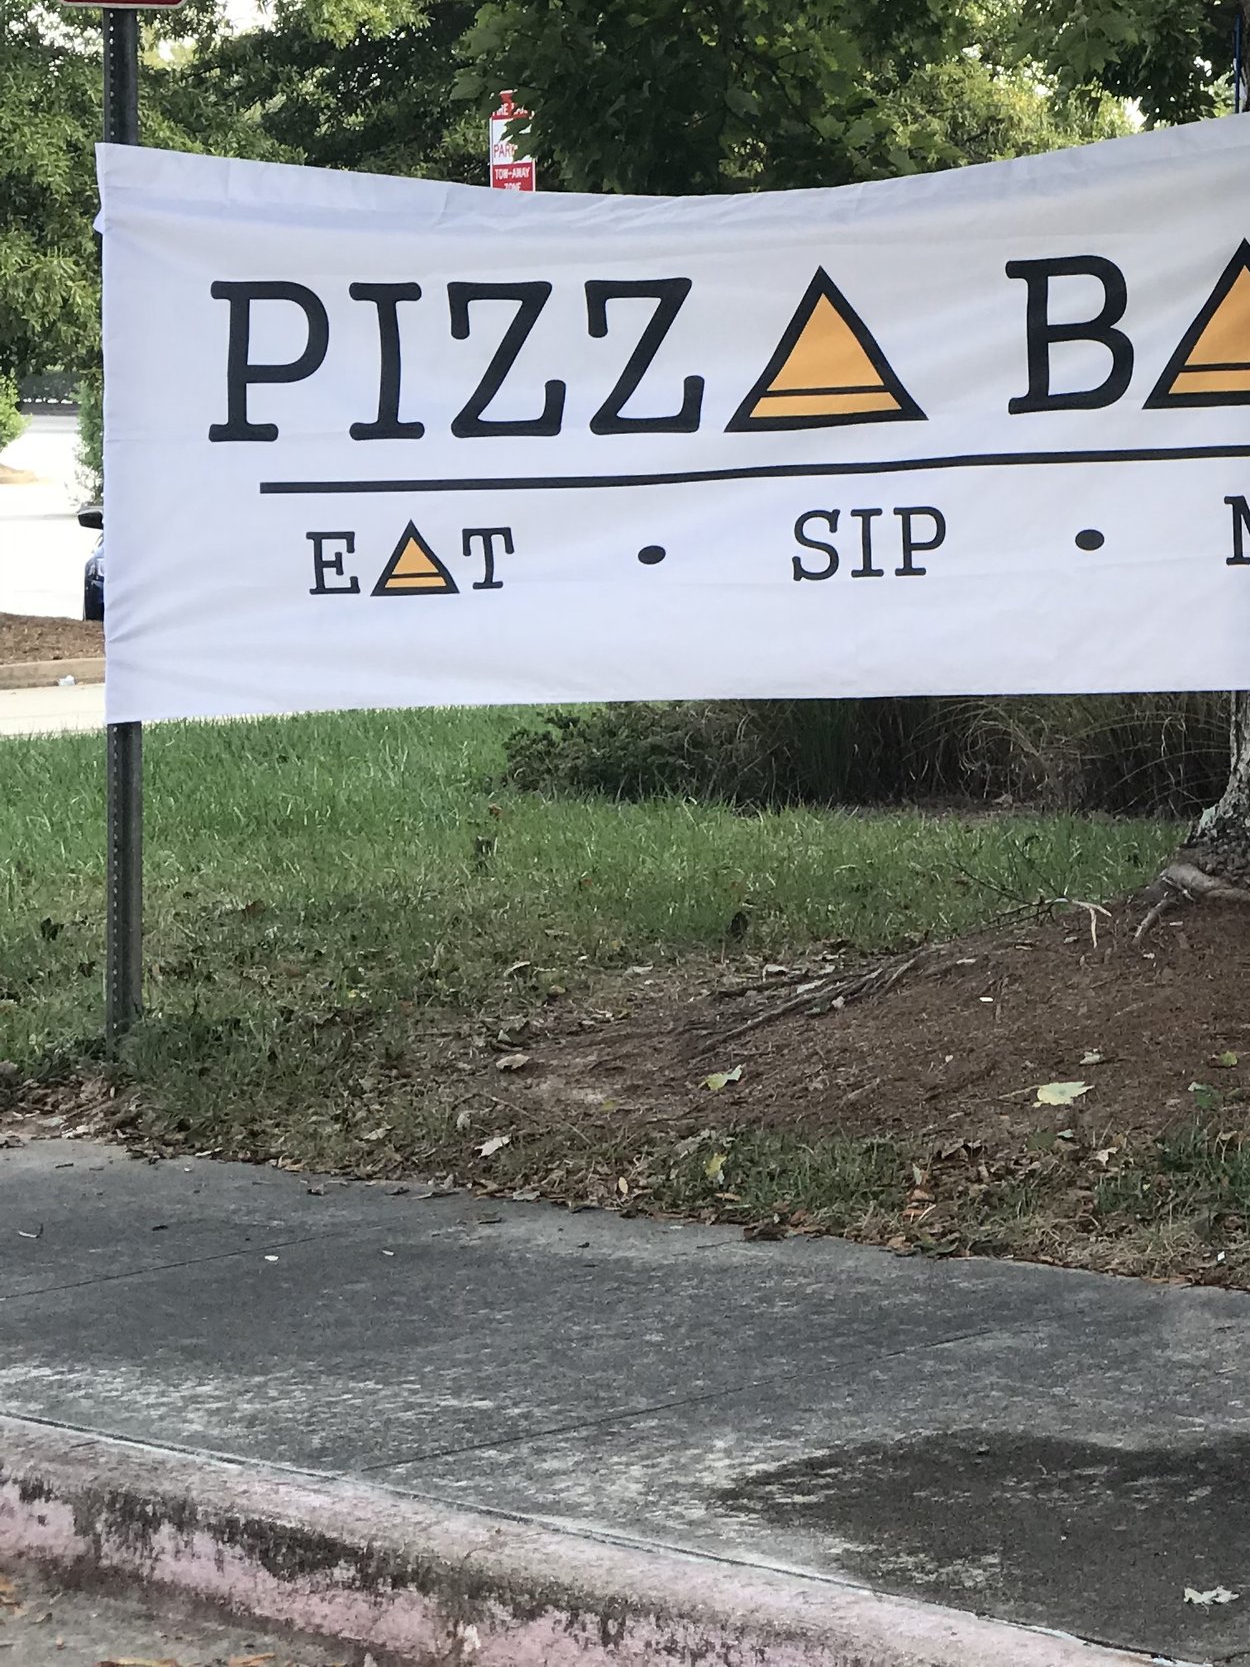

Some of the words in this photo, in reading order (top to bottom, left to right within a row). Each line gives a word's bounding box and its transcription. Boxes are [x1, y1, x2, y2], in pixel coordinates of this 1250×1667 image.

[495, 167, 531, 180] TOW-AWAY
[207, 265, 928, 443] PIZZA
[308, 518, 516, 598] EAT
[790, 504, 947, 582] SIP
